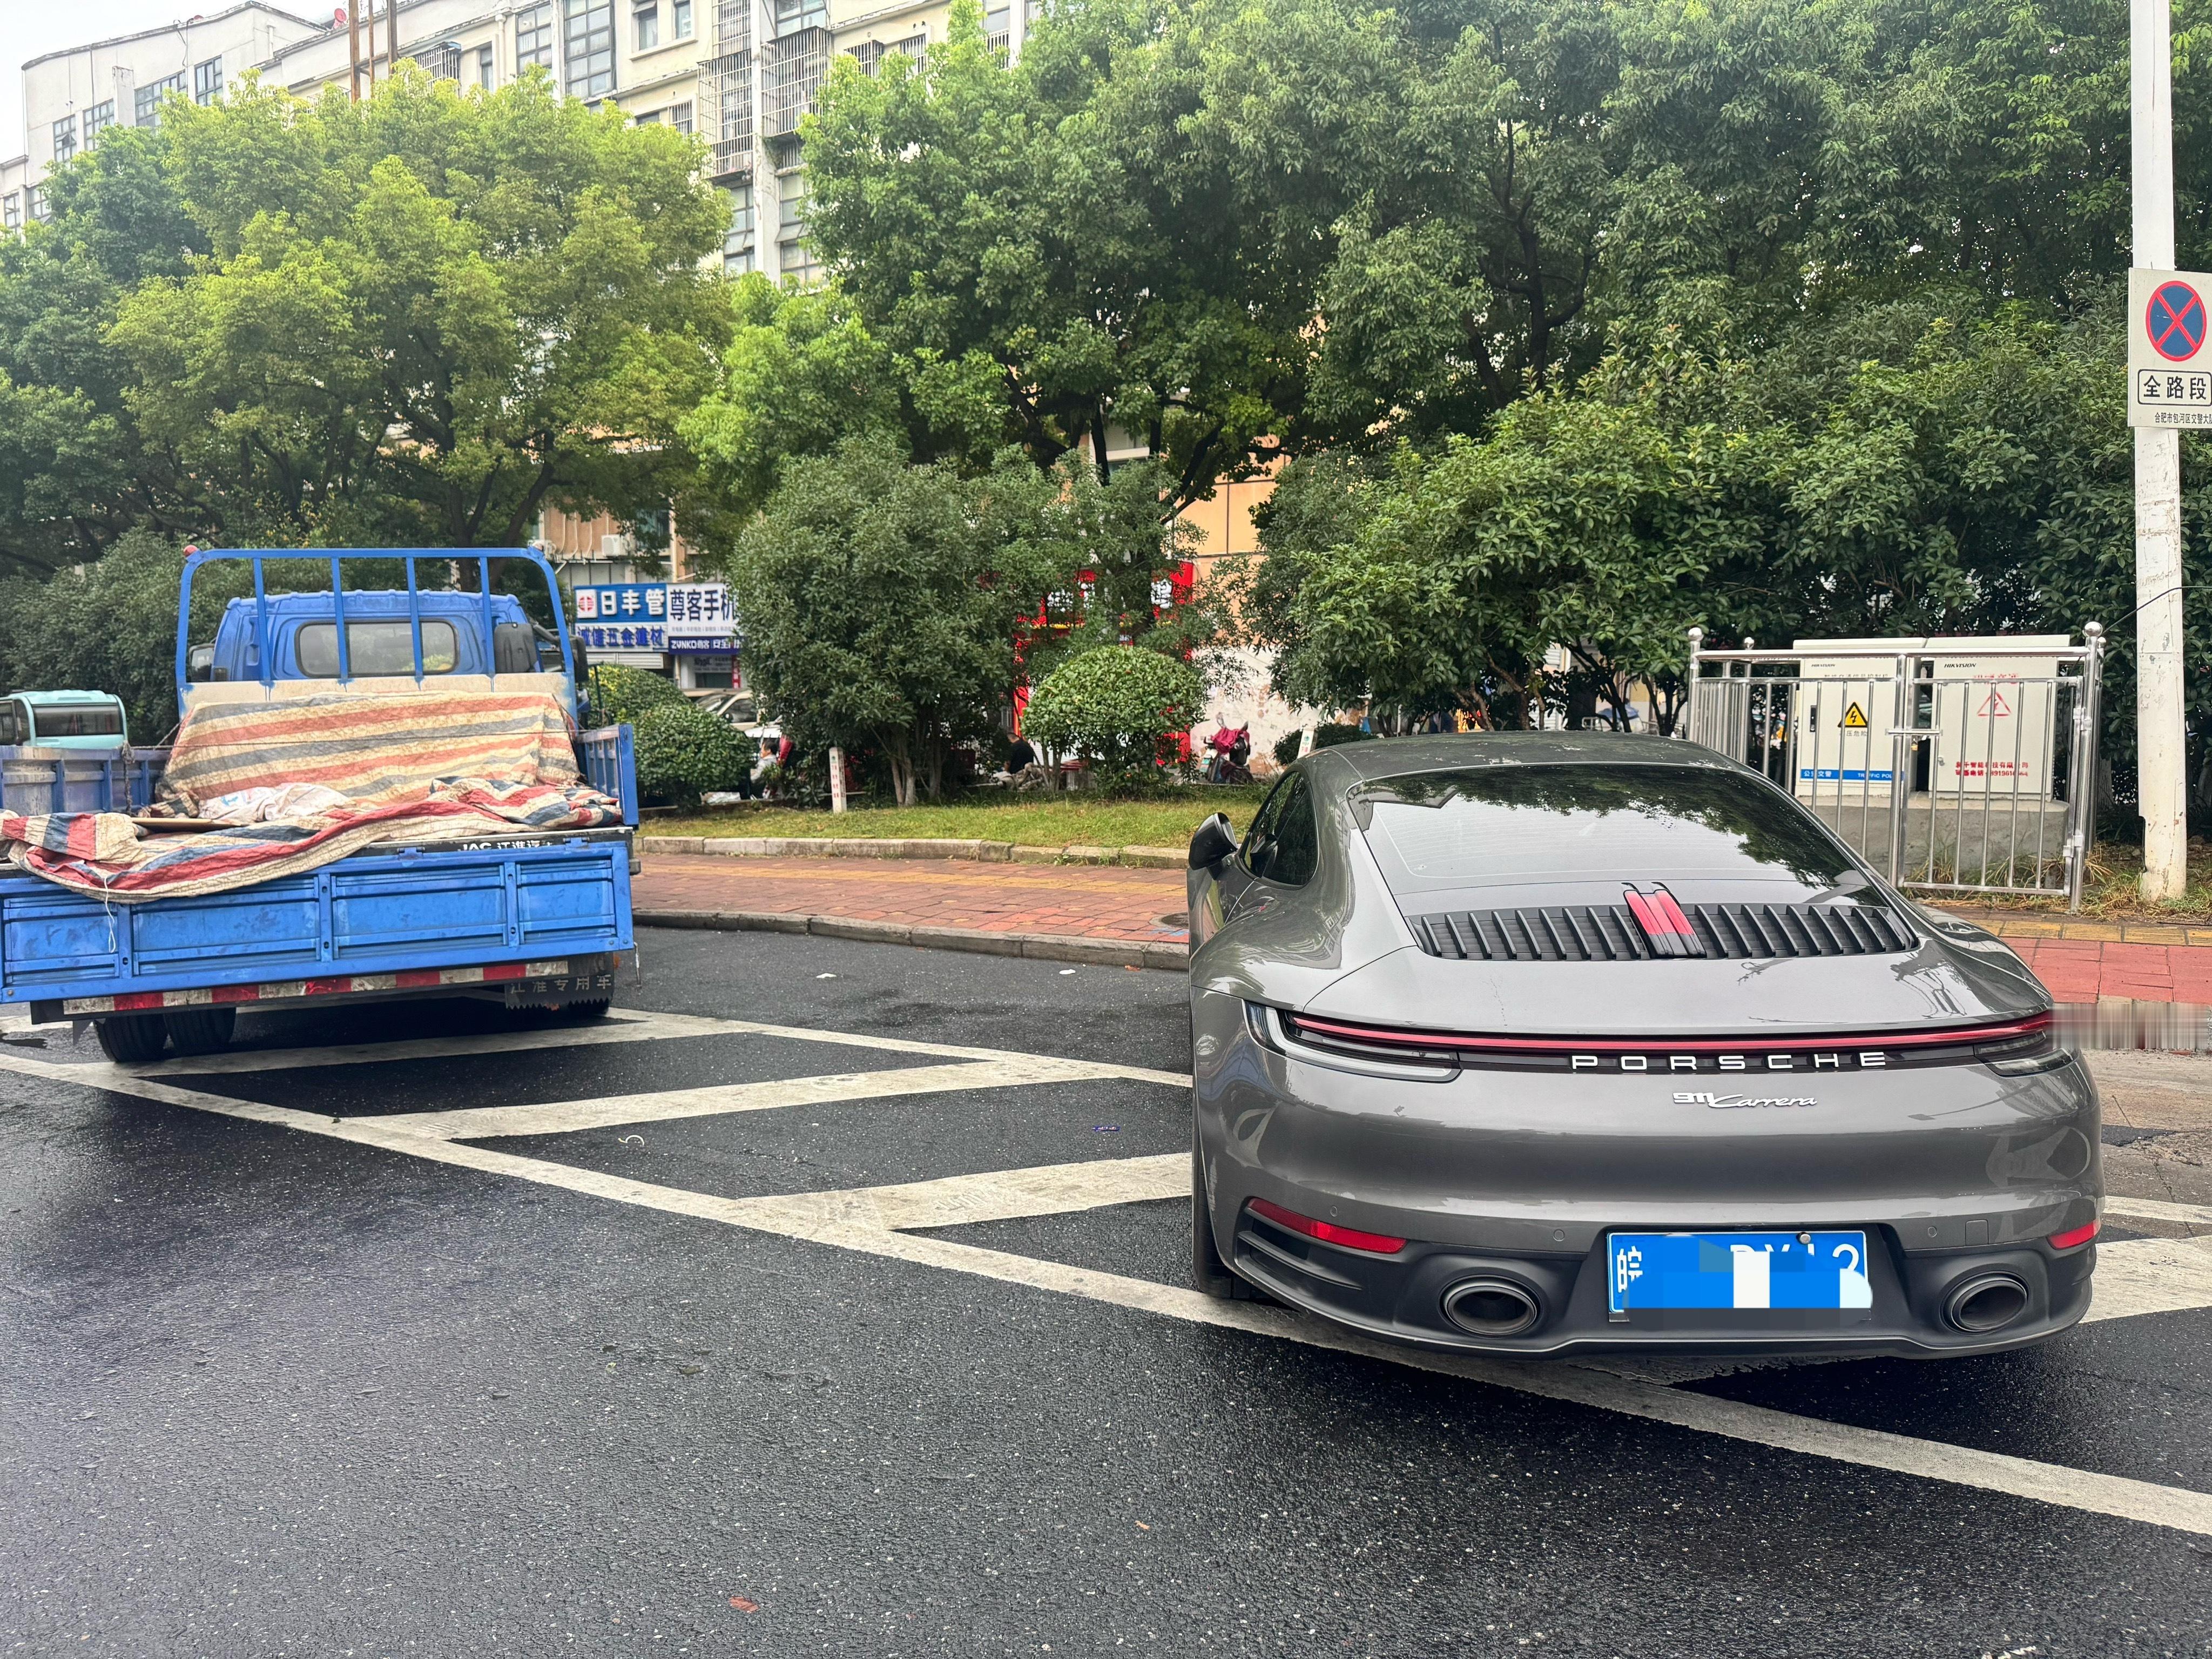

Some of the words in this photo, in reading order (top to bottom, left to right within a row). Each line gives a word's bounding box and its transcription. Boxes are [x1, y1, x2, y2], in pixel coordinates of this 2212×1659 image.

[2143, 375, 2207, 400] 全路段
[601, 589, 665, 616] 日丰管
[670, 588, 736, 622] 尊客手机
[458, 842, 492, 851] JAC
[497, 840, 552, 850] 江淮汽
[1572, 1051, 1886, 1070] PORSCHE
[1708, 1094, 1818, 1108] Carrera
